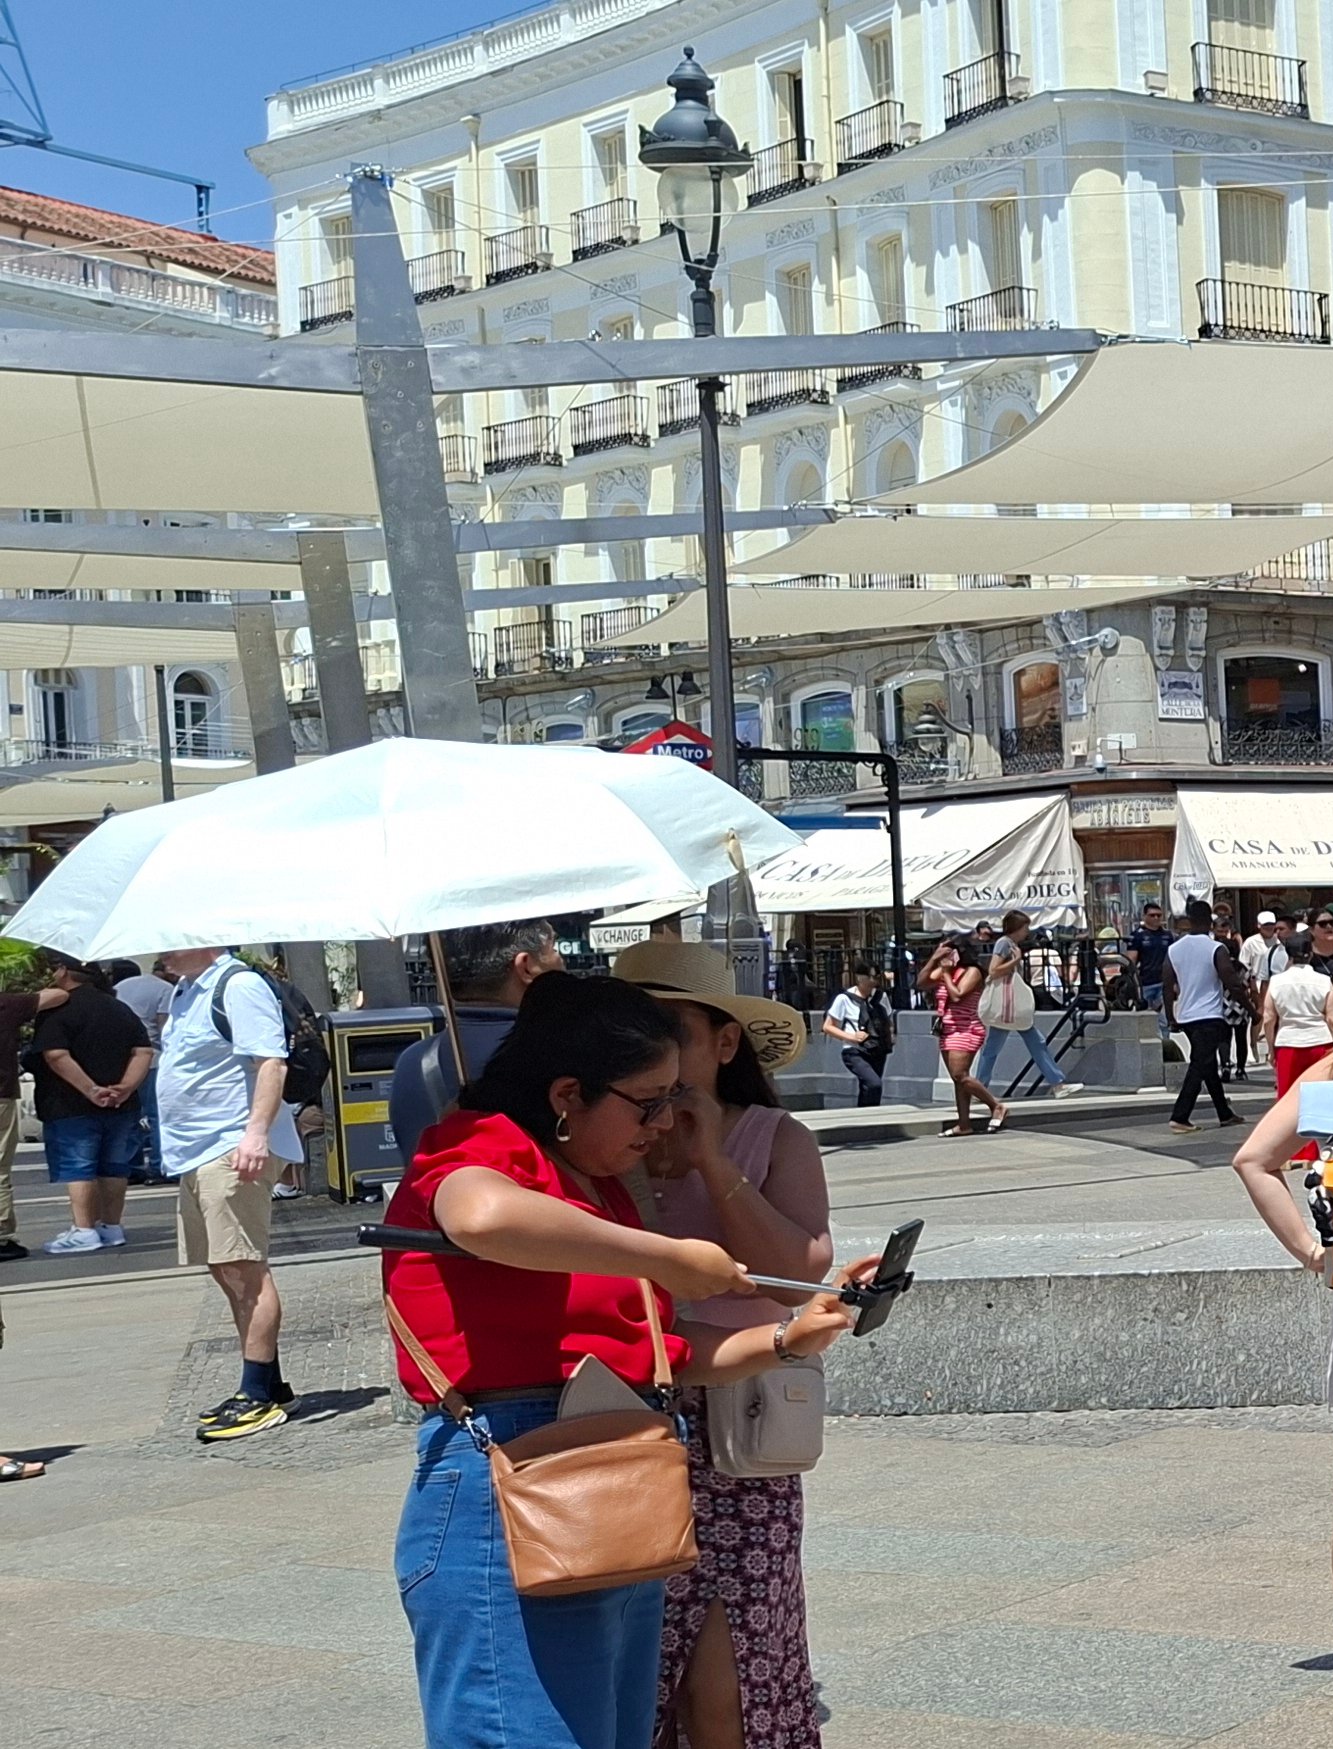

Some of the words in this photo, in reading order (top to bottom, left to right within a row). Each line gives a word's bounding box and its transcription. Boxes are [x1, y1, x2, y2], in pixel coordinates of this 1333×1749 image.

[657, 745, 704, 760] Metro
[1208, 838, 1284, 855] CASA
[1290, 846, 1310, 855] DE
[1231, 860, 1297, 869] ABANICOS
[956, 886, 1006, 901] CASA
